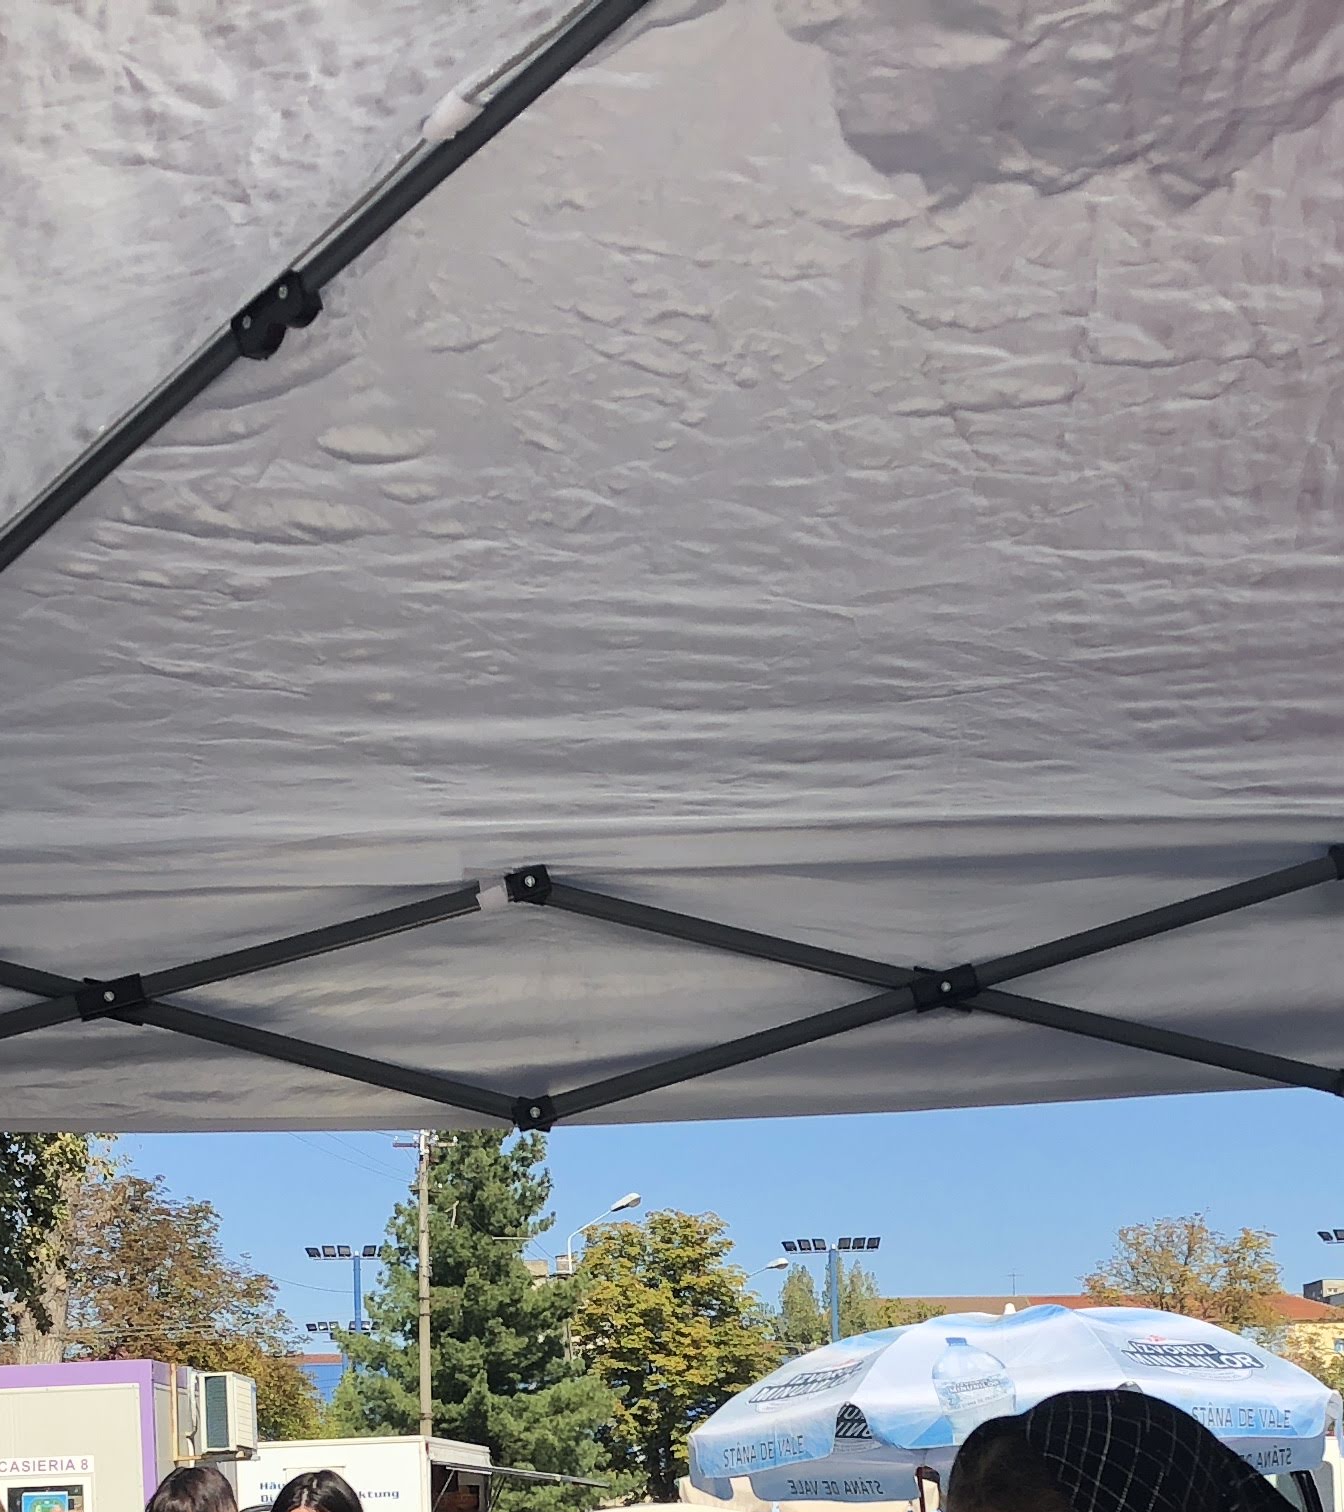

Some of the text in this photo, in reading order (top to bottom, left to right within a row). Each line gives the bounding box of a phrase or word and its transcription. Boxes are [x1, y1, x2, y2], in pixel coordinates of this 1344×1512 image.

[1129, 1342, 1220, 1355] IZVORUL
[1127, 1350, 1263, 1369] MINUNILOR
[1239, 1408, 1254, 1427] DE
[1258, 1409, 1291, 1428] VALE
[723, 1435, 804, 1467] STÂNA DE VALE
[80, 1459, 89, 1470] 8
